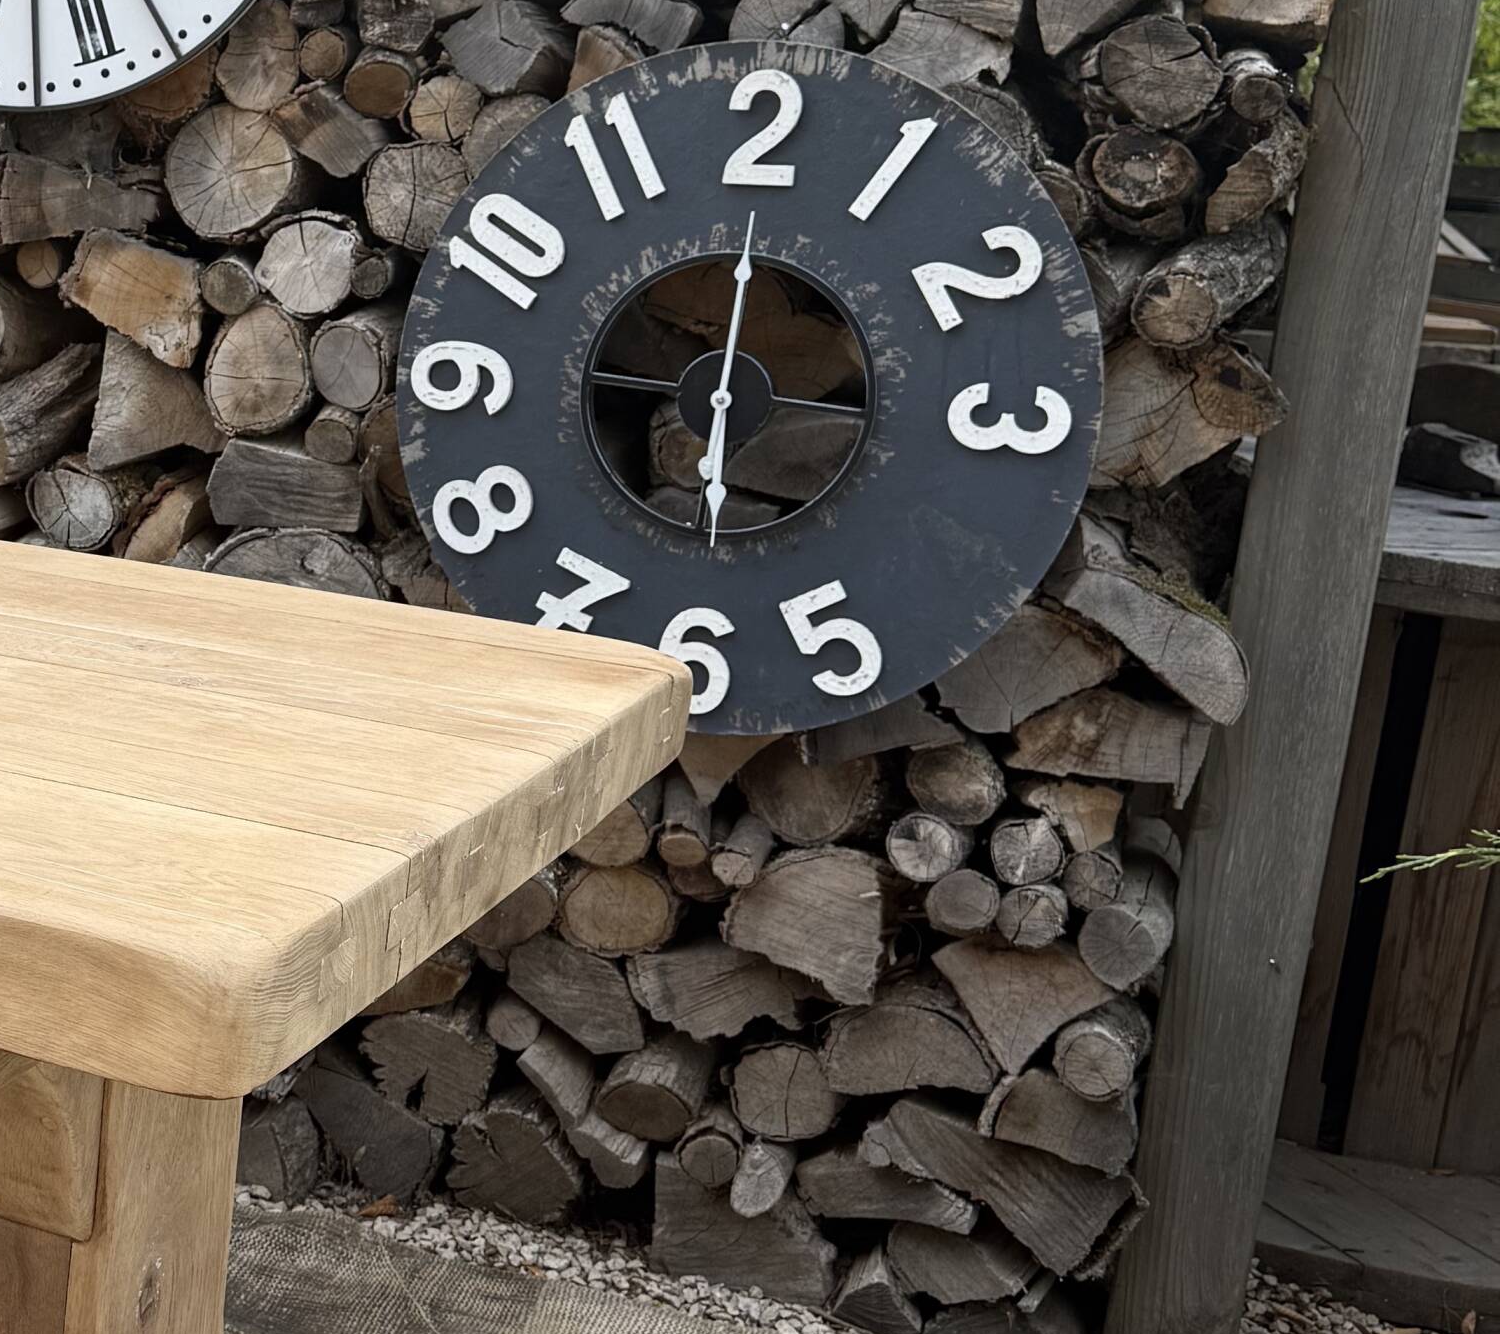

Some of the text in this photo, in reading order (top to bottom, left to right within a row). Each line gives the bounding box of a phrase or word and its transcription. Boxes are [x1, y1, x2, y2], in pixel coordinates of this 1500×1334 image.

[563, 92, 666, 221] 11
[722, 69, 803, 186] 2
[847, 117, 938, 221] 1
[448, 193, 566, 310] 10
[911, 225, 1042, 332] 2
[410, 340, 513, 415] 9
[946, 382, 1072, 455] 3
[432, 465, 534, 554] 8
[534, 546, 631, 633] 7
[778, 579, 882, 696] 5
[658, 607, 735, 715] 6
